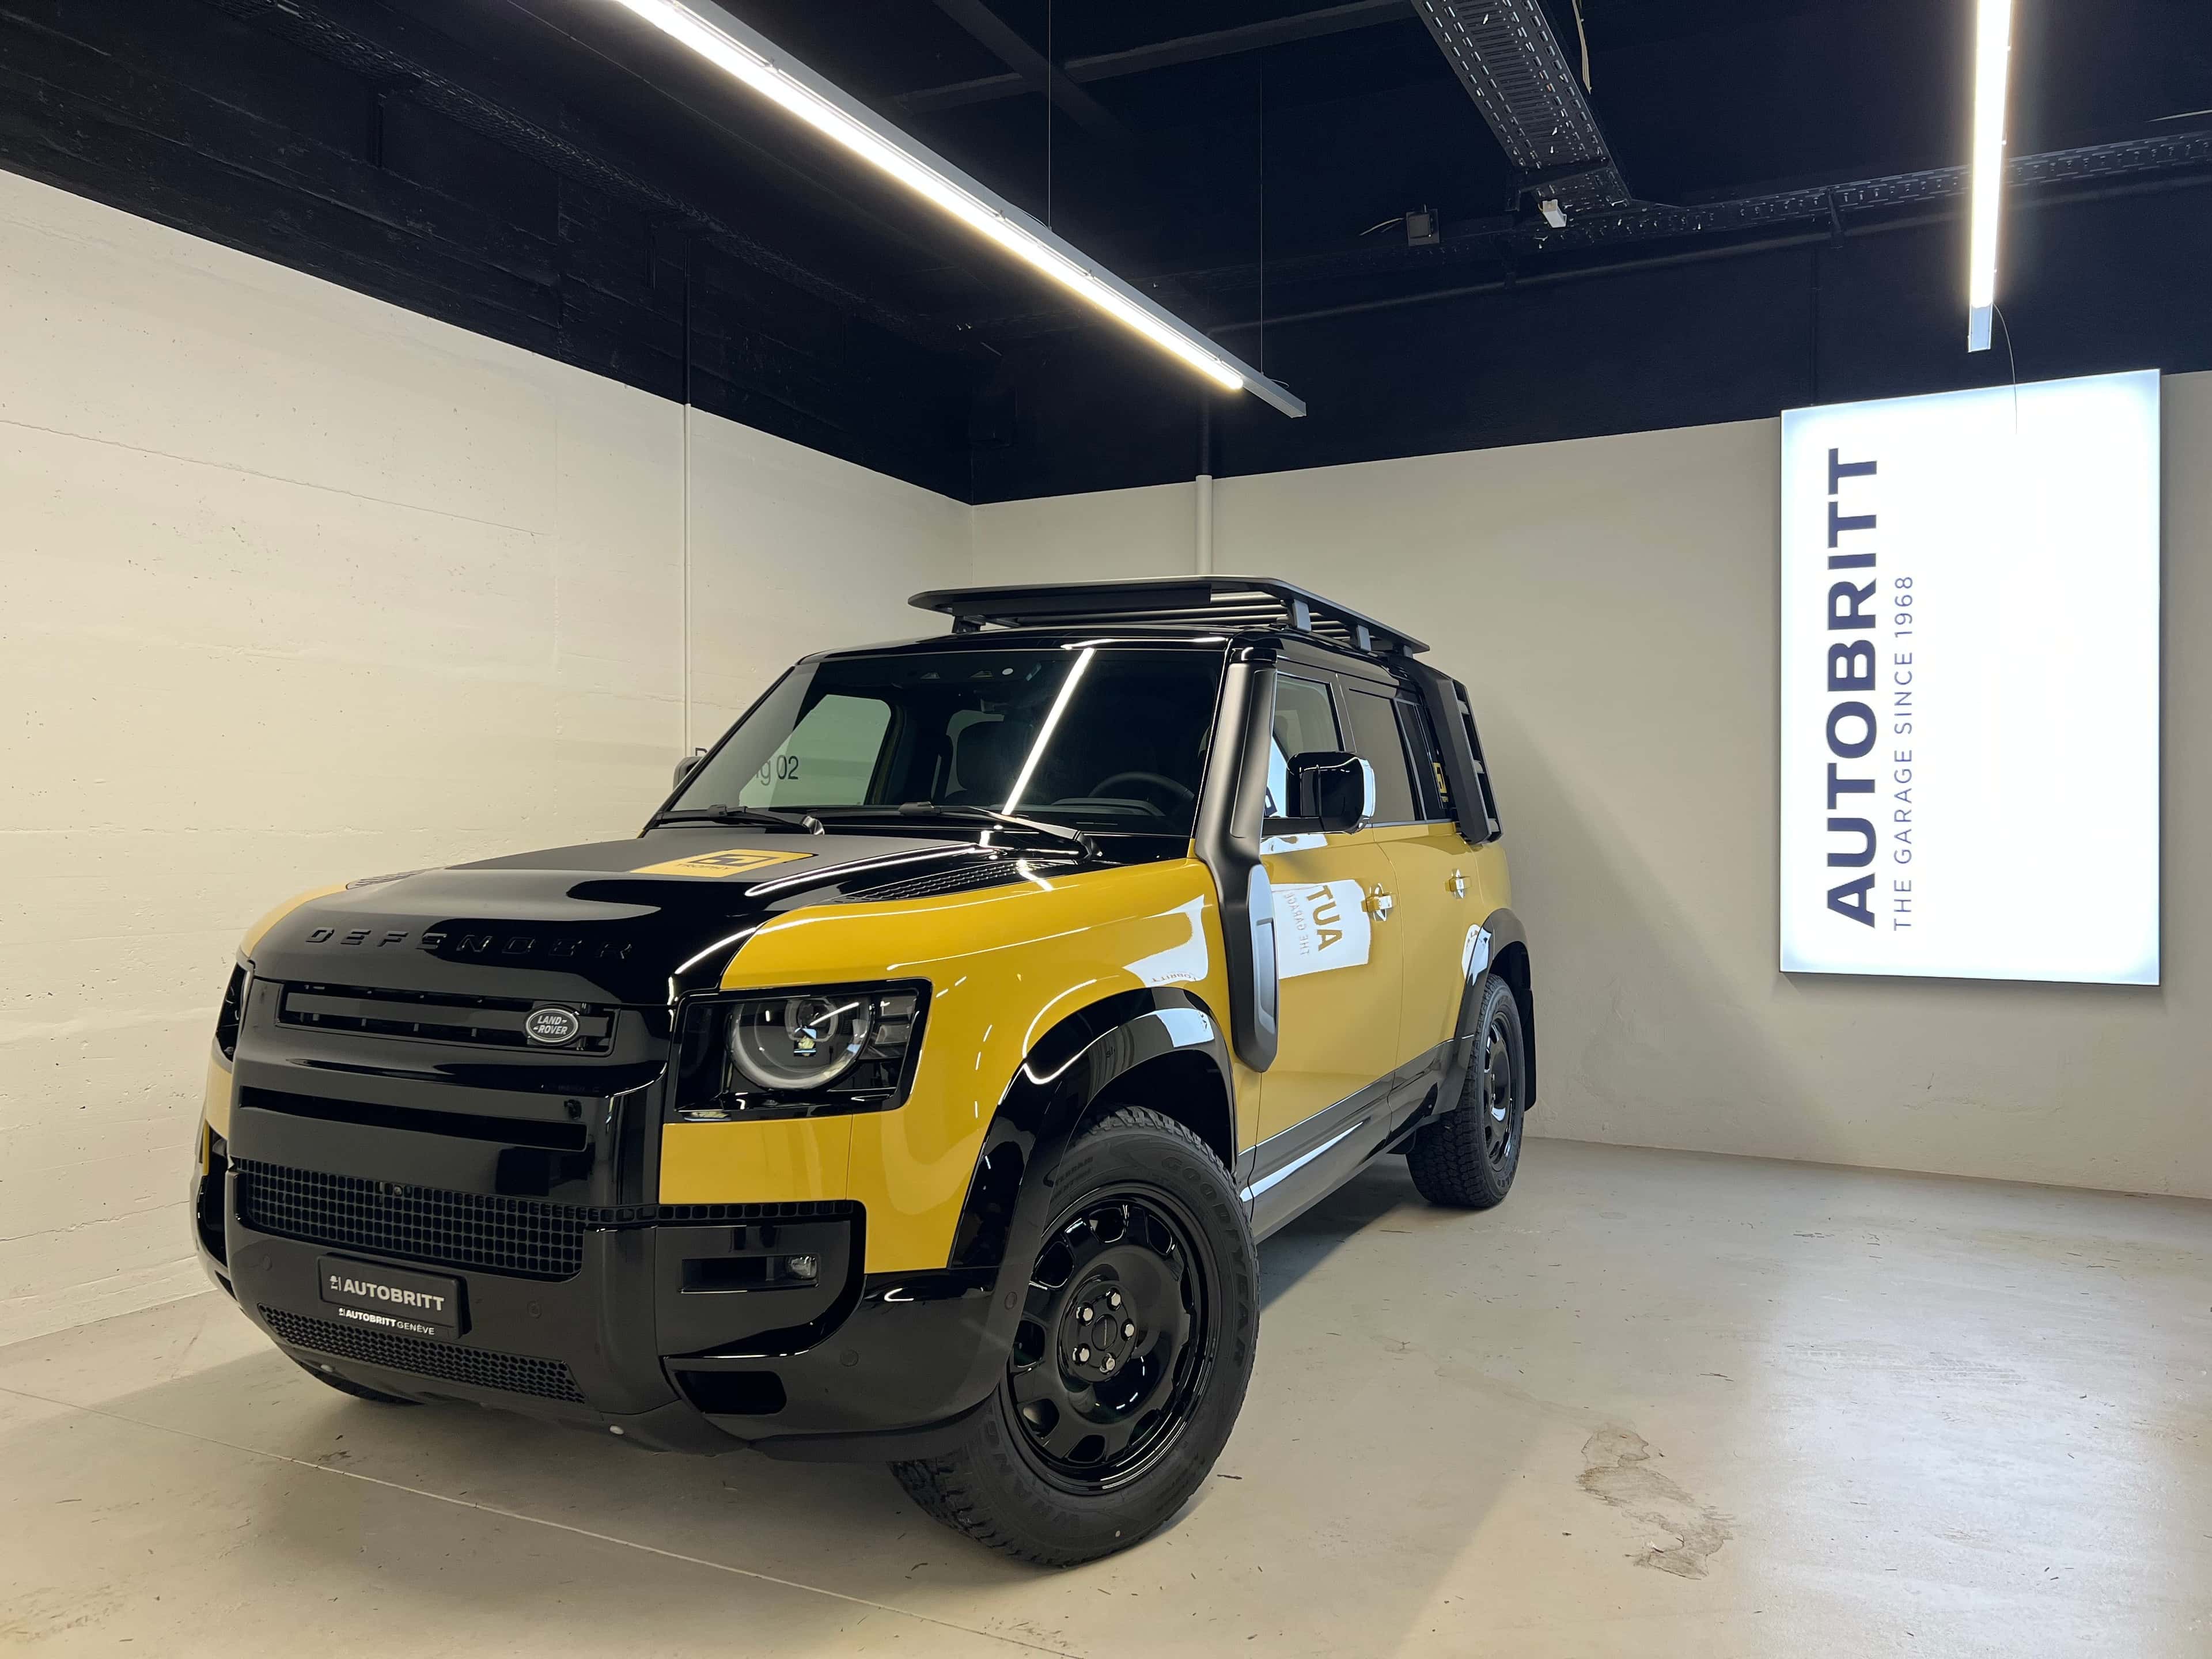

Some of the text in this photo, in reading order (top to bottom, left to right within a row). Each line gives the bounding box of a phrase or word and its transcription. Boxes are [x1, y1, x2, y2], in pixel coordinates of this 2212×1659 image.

[1825, 448, 1877, 929] AUTOBRITT
[776, 755, 799, 780] 02
[1893, 577, 1913, 931] THE GARAGE SINCE 1968
[305, 926, 632, 960] DEFENDER
[537, 1015, 562, 1025] LAND
[537, 1024, 569, 1035] ROVER
[343, 1278, 445, 1311] AUTOBRITT
[346, 1309, 397, 1327] AUTOBRITT
